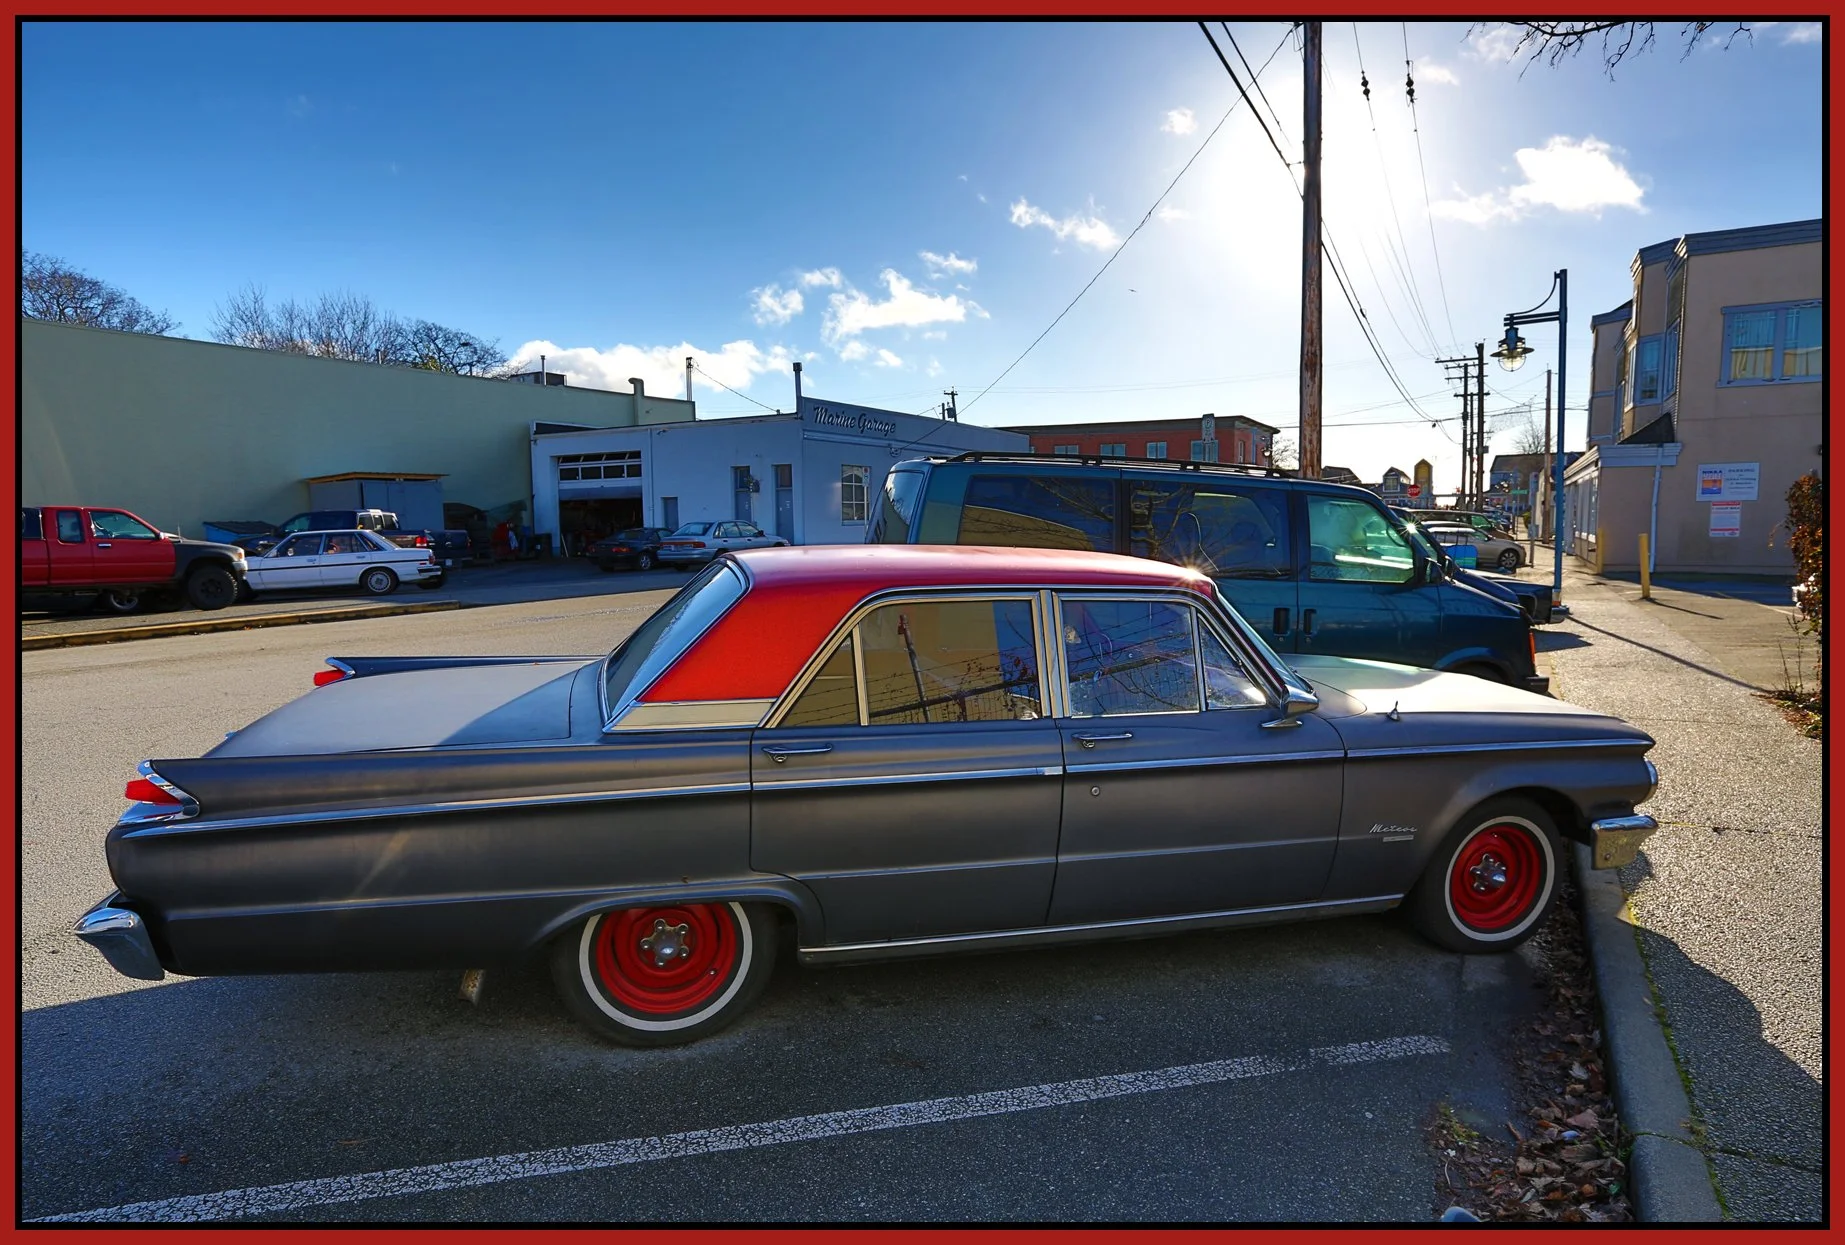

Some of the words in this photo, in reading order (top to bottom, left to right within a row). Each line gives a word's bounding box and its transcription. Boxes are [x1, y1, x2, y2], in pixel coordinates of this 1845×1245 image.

[813, 406, 856, 429] Marine
[857, 413, 896, 437] Garage
[1369, 823, 1418, 833] Meteor
